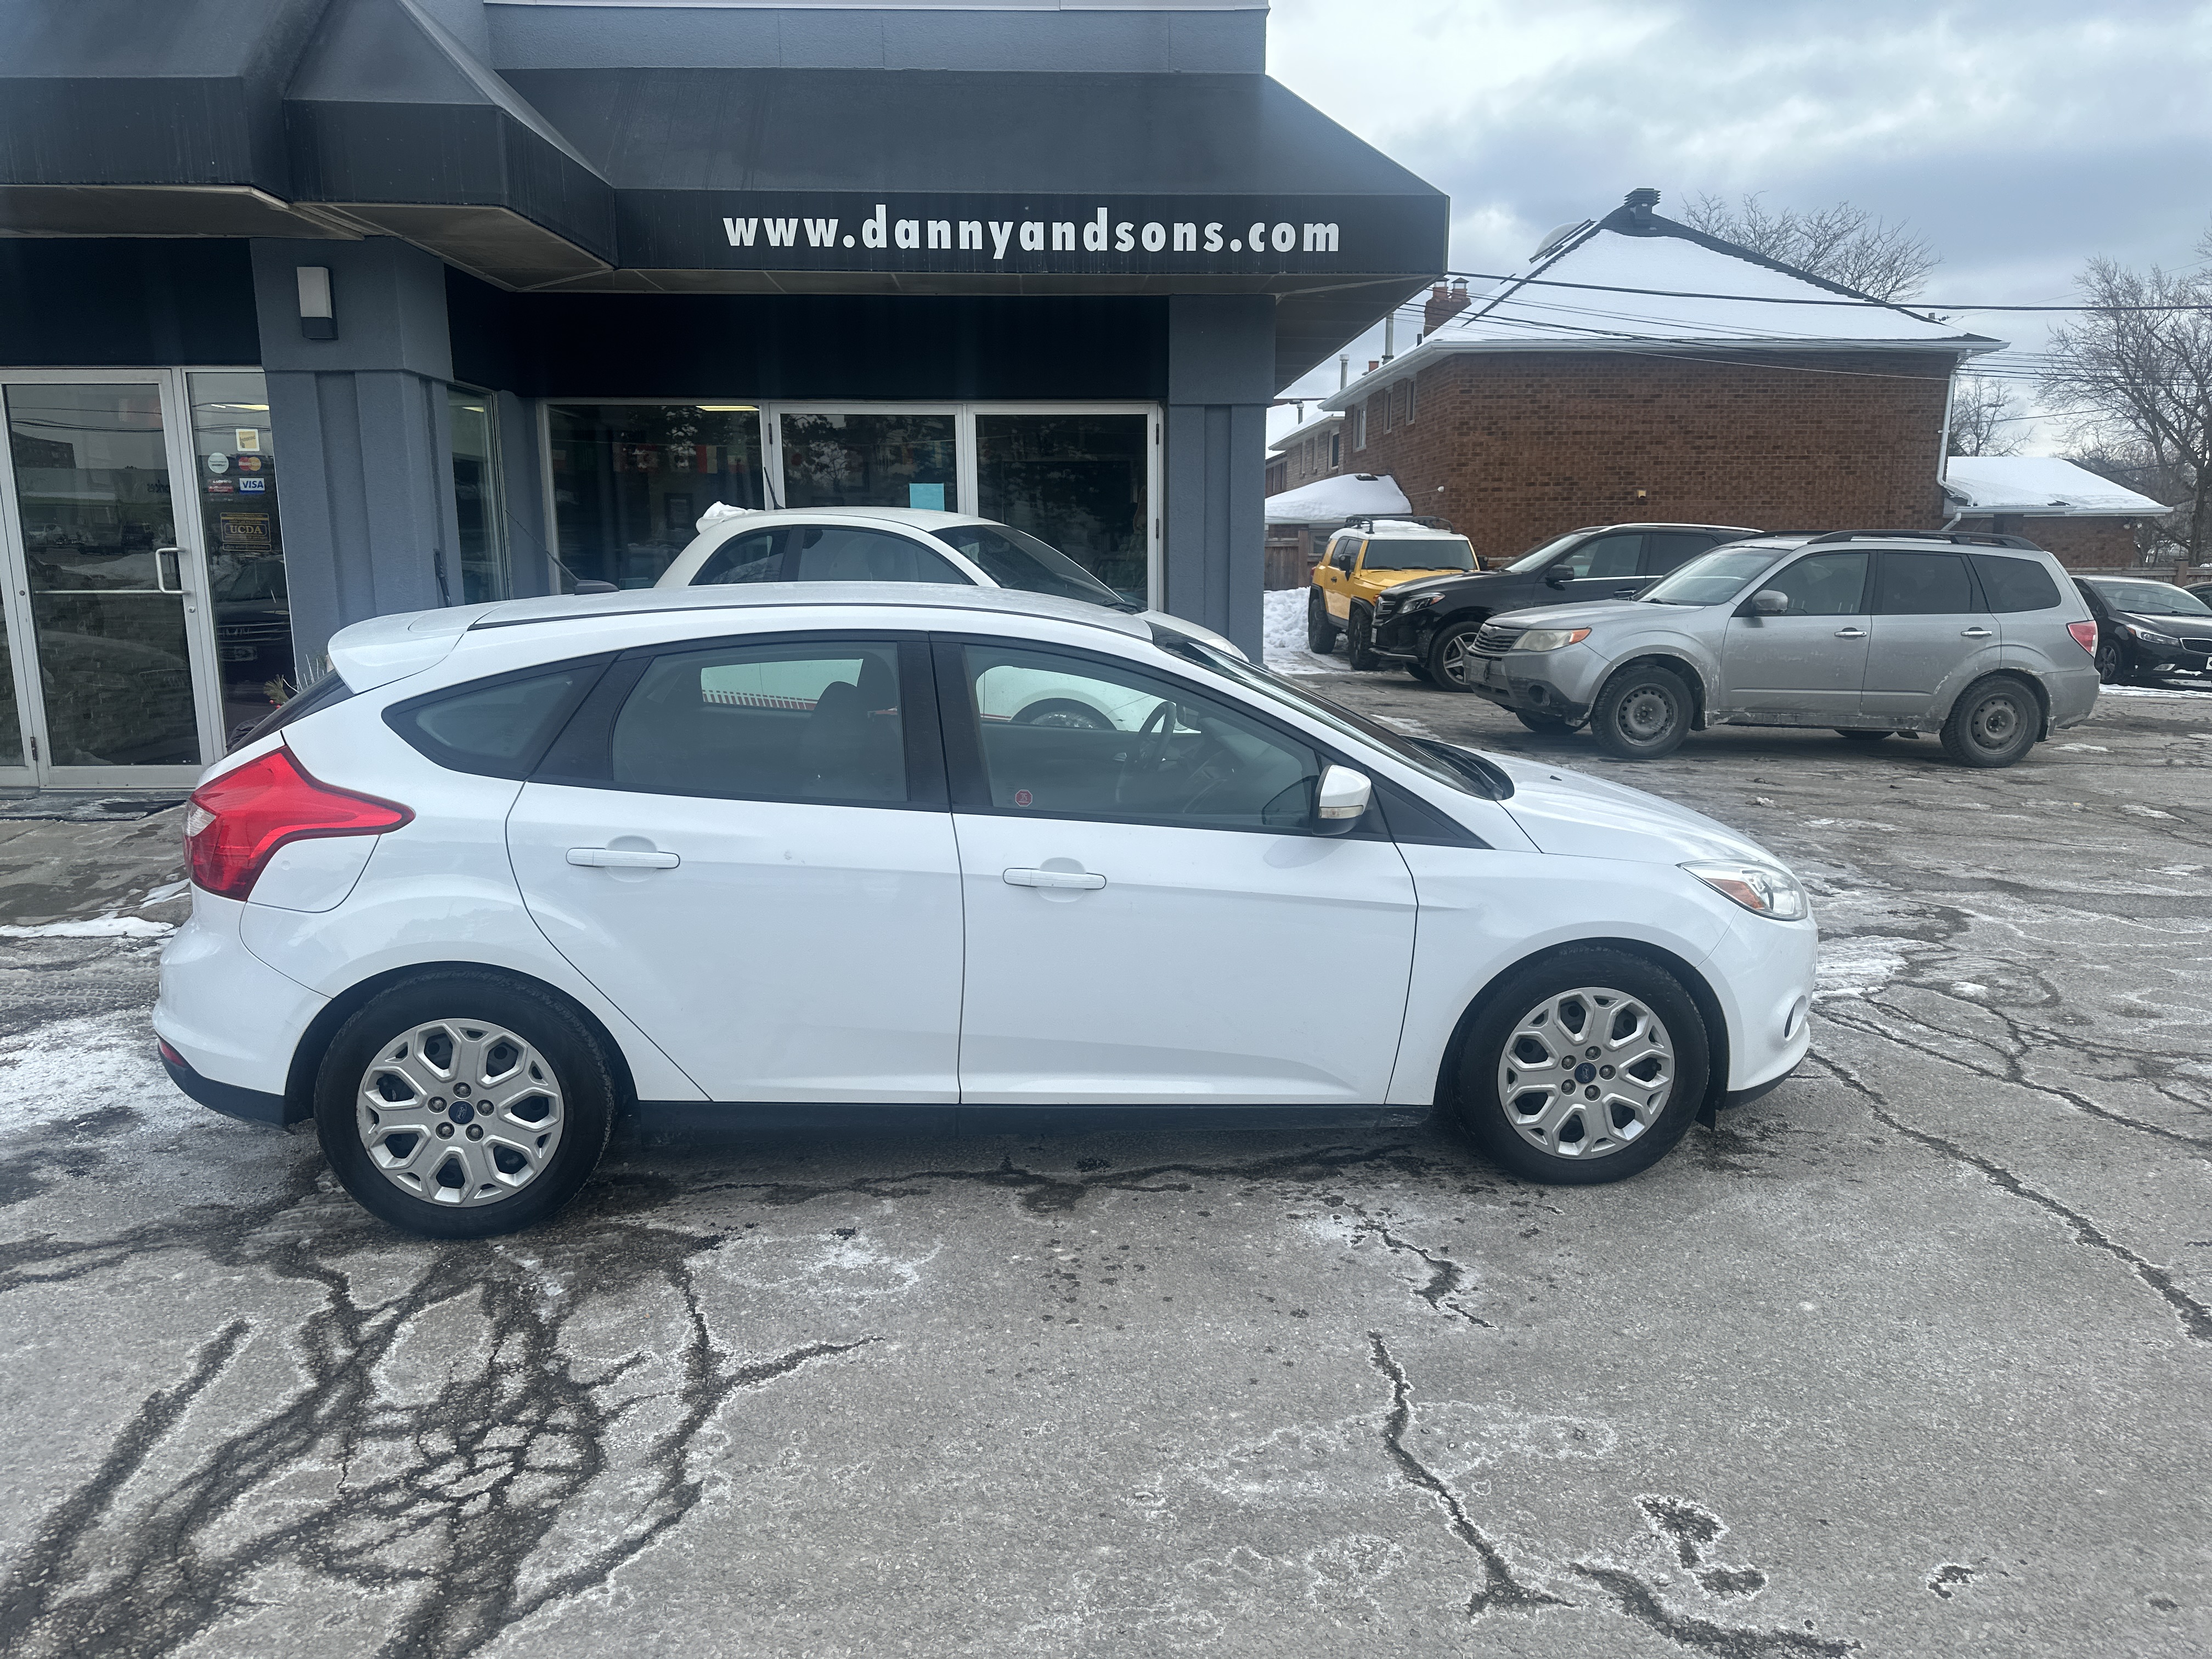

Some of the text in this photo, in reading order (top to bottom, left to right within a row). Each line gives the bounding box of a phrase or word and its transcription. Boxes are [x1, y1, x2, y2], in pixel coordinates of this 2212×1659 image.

[723, 204, 1340, 260] www.dannyandsons.com
[242, 480, 264, 488] VISA
[229, 525, 263, 534] UCDA
